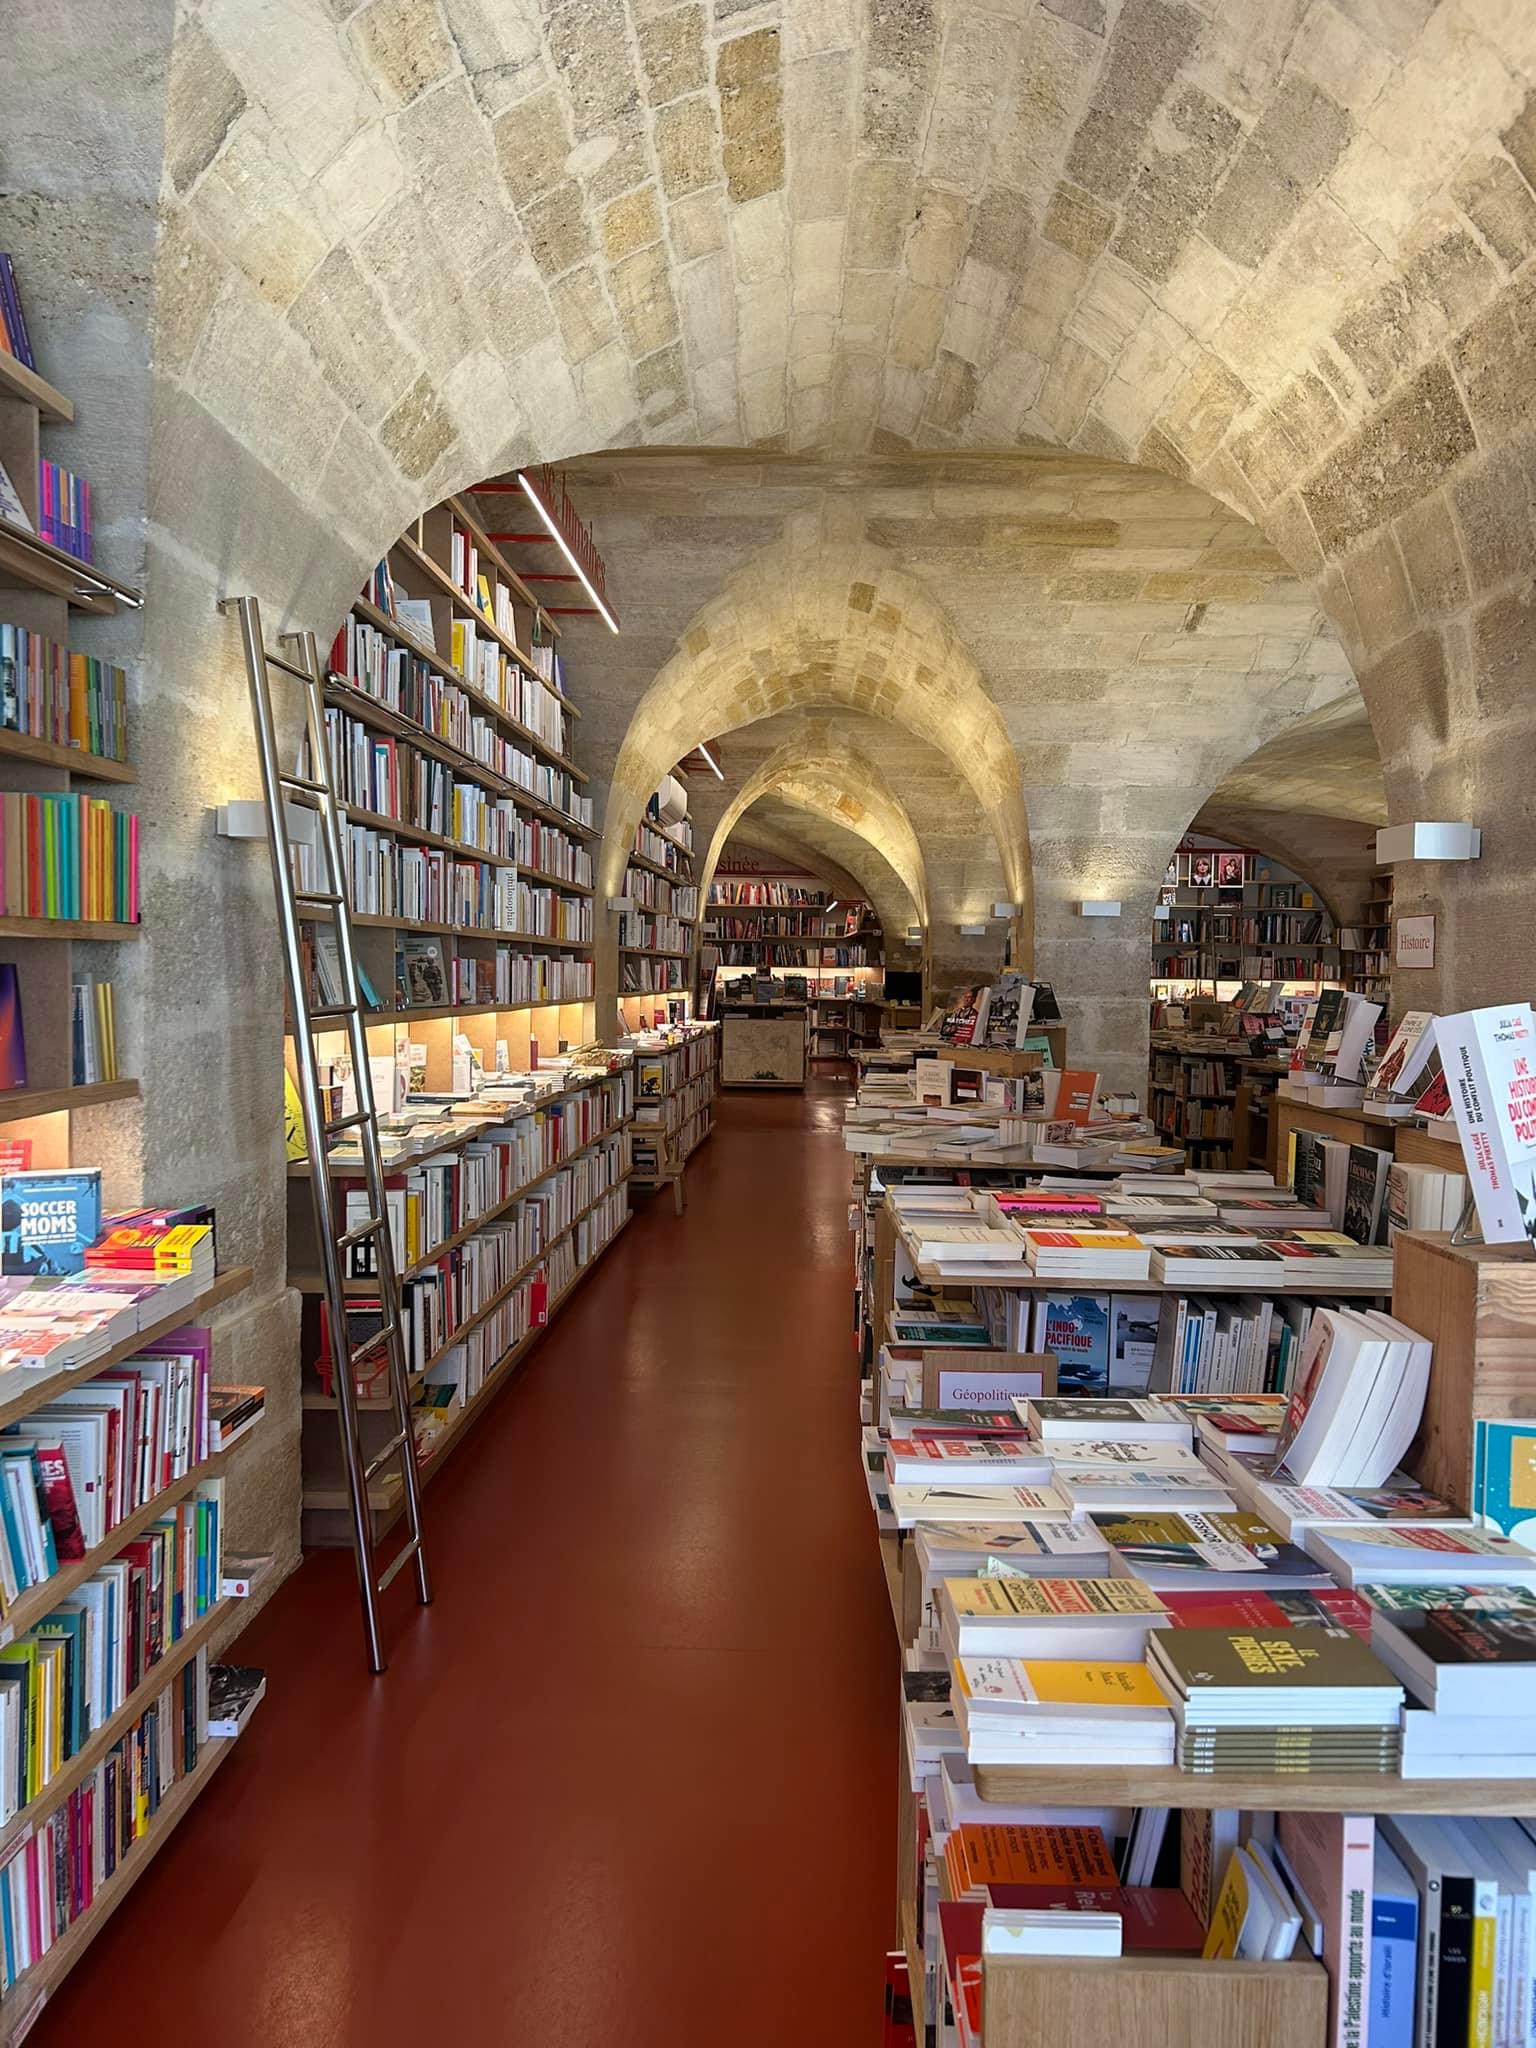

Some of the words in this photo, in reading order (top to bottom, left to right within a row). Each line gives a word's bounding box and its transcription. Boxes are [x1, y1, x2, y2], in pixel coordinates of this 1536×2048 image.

[506, 873, 515, 926] philosophie
[1400, 933, 1431, 950] Histoire
[1459, 1046, 1475, 1081] POLITIQUE
[1514, 1057, 1528, 1076] UNE
[1459, 1079, 1473, 1111] HISTOIRE
[1468, 1083, 1483, 1113] CONFLIT
[1465, 1111, 1476, 1124] UNE
[1476, 1113, 1484, 1123] DU
[1508, 1102, 1522, 1121] DU
[1480, 1132, 1495, 1160] PIKETTY
[1475, 1152, 1487, 1170] JULIA
[1486, 1160, 1501, 1190] THOMAS
[21, 1200, 76, 1217] SOCCER
[21, 1215, 77, 1235] MOMS
[1046, 1332, 1093, 1348] PACIFIQUE
[1184, 1512, 1222, 1544] OFFSHOR
[1006, 1583, 1035, 1609] OPTIMISTE
[1228, 1636, 1277, 1674] PIERRES
[1260, 1640, 1306, 1668] SEXE
[1299, 1648, 1319, 1657] LE
[1347, 1889, 1364, 1923] monde
[1350, 1926, 1364, 1938] au
[1346, 1942, 1366, 1979] apporte
[1344, 1982, 1362, 2028] Palestine
[1381, 1982, 1392, 2019] Histoire
[1344, 2030, 1360, 2041] la
